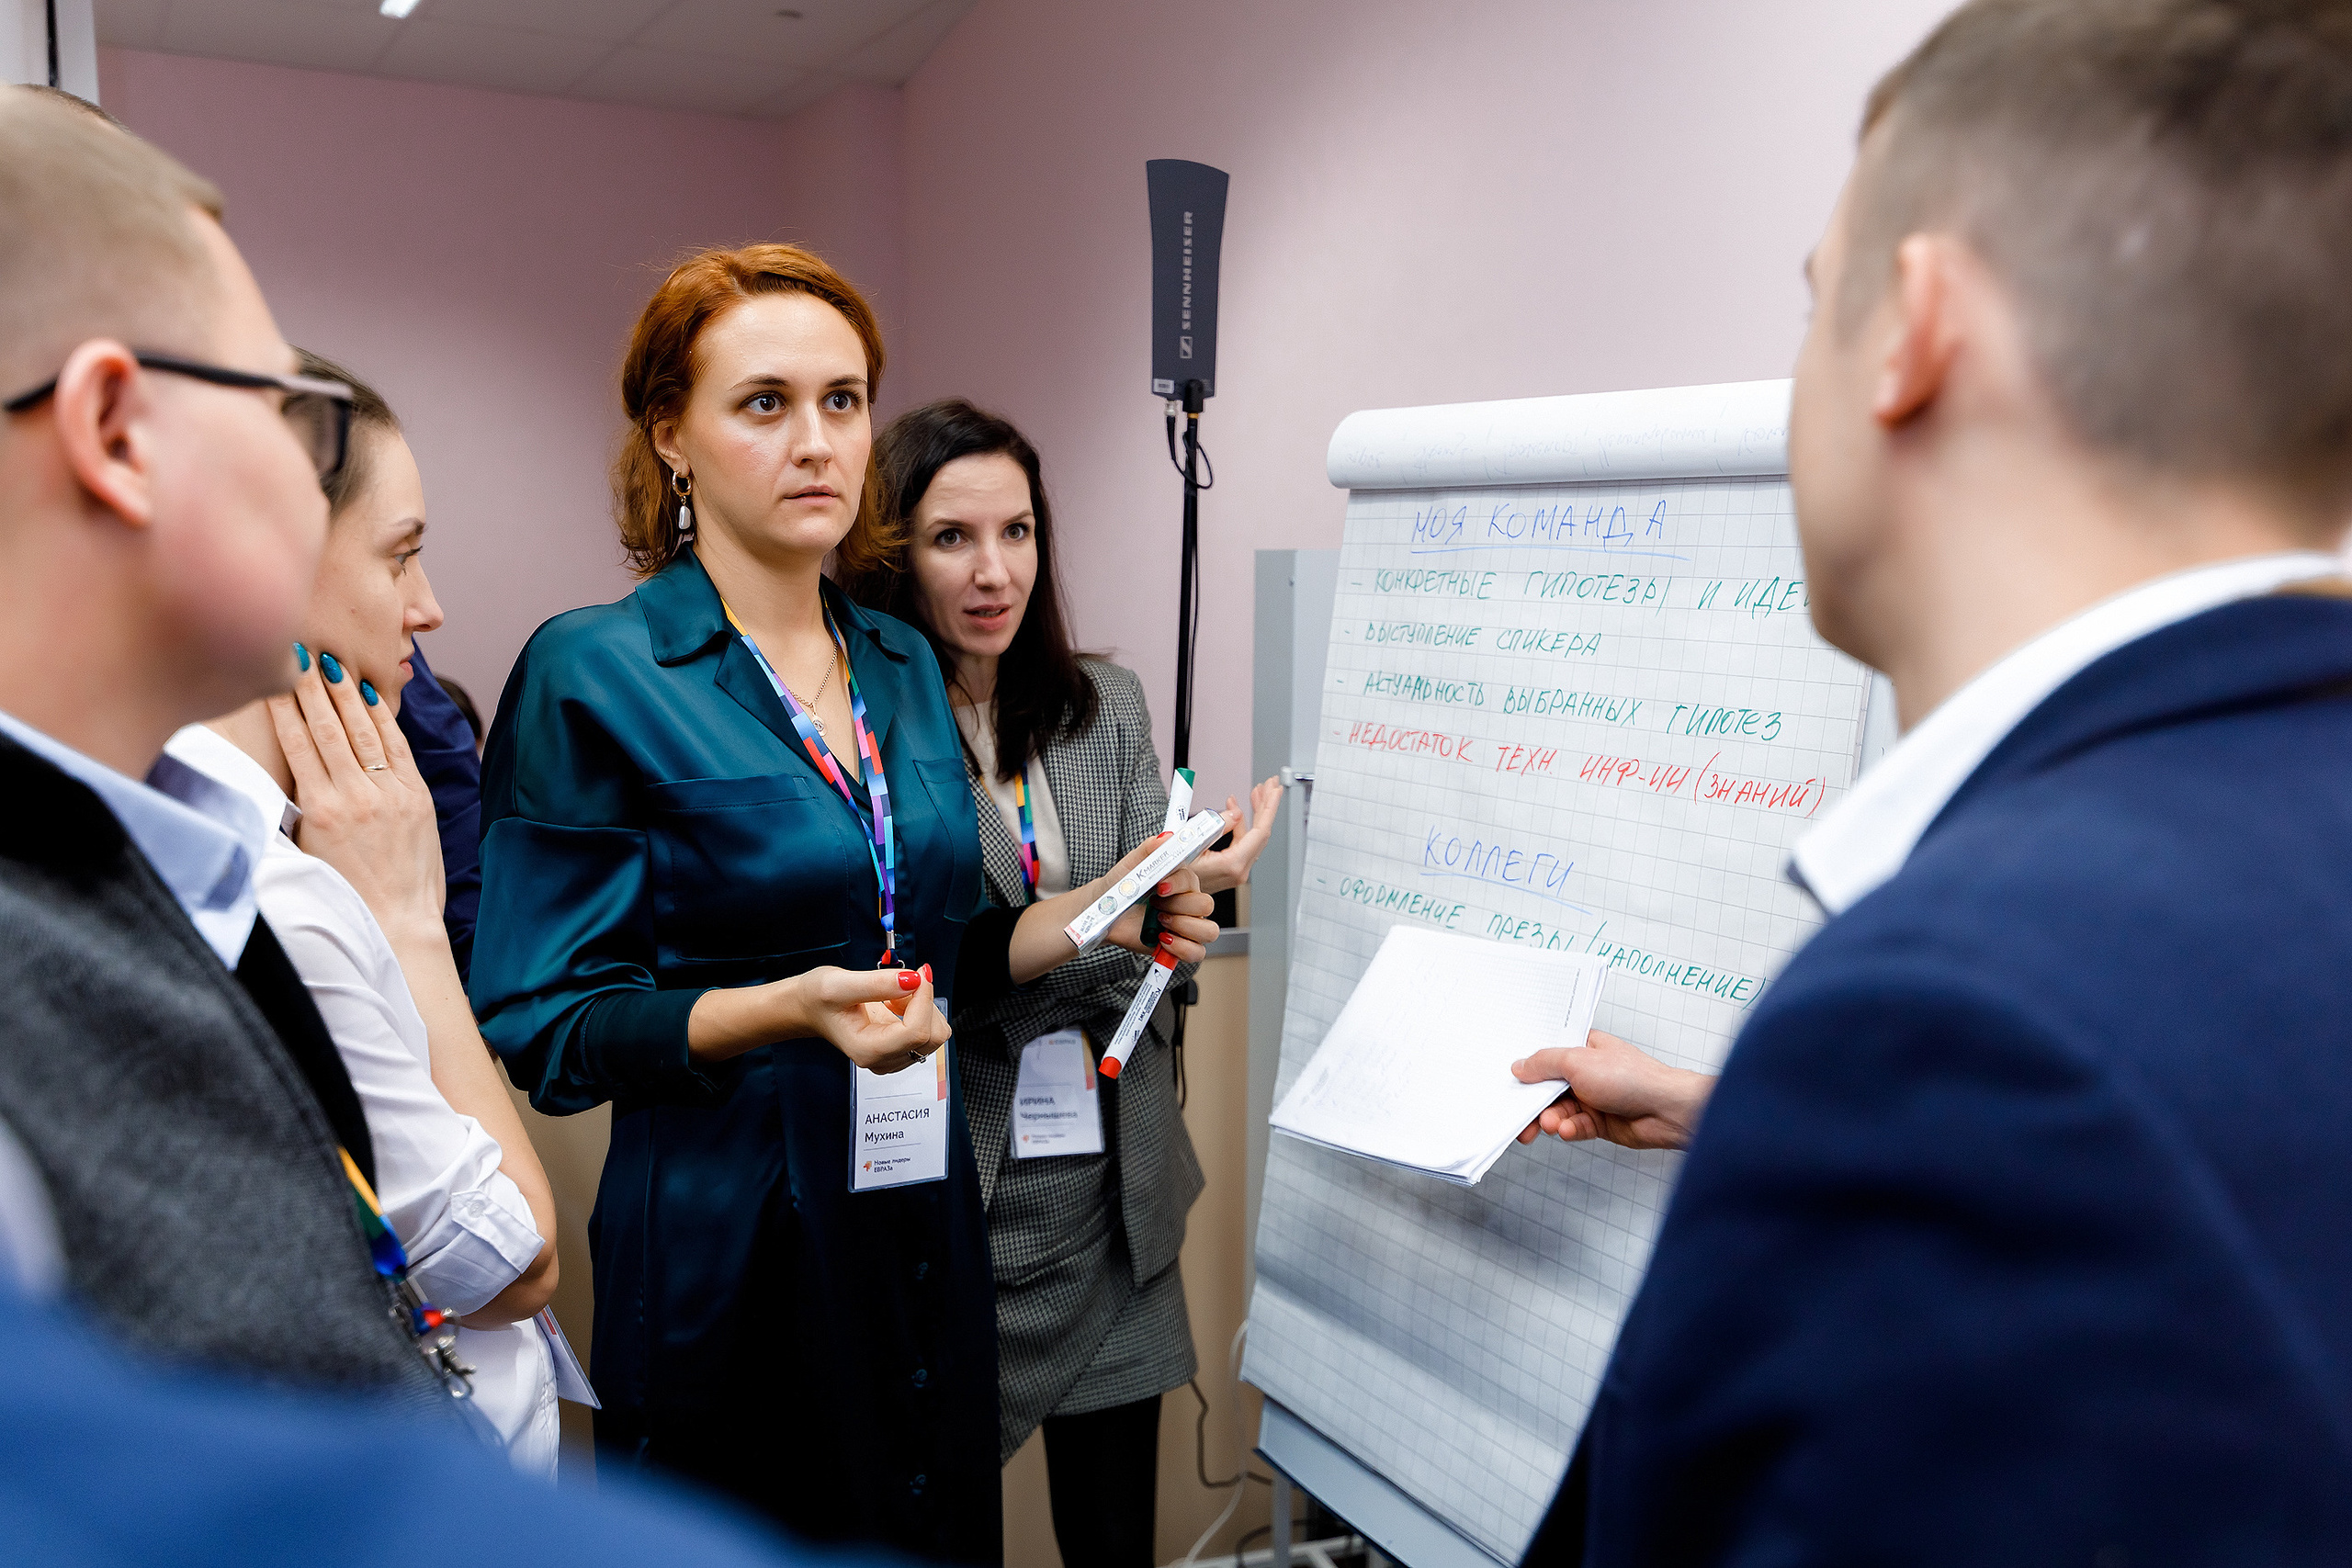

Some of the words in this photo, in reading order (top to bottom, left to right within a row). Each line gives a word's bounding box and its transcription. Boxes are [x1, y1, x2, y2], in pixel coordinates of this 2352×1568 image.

[1182, 210, 1193, 331] SENNHEISER
[1411, 505, 1467, 545] МОЯ
[1487, 499, 1667, 552] КОМАНДА
[1374, 569, 1497, 600] КОНКРЕТНЫЕ
[1524, 571, 1672, 617] ГИПОТЕЗЫ
[1697, 580, 1723, 610] И
[1364, 622, 1482, 647] ВЫСТУПЛЕНИЕ
[1496, 628, 1602, 658] СПИКЕРА
[1363, 671, 1485, 706] АКТУАЛЬНОСТЬ
[1503, 686, 1643, 728] ВЫБРАННЫХ
[1349, 722, 1474, 762] НЕДОСТАТОК
[1694, 750, 1826, 819] (ЗНАНИЙ)
[1425, 825, 1575, 897] КОЛЛЕГИ
[1340, 876, 1466, 929] ОФОРМЛЕНИЕ
[1487, 913, 1575, 952] ПРЕЗЫ
[865, 1108, 930, 1125] АНАСТАСИЯ
[865, 1131, 905, 1145] Мухина
